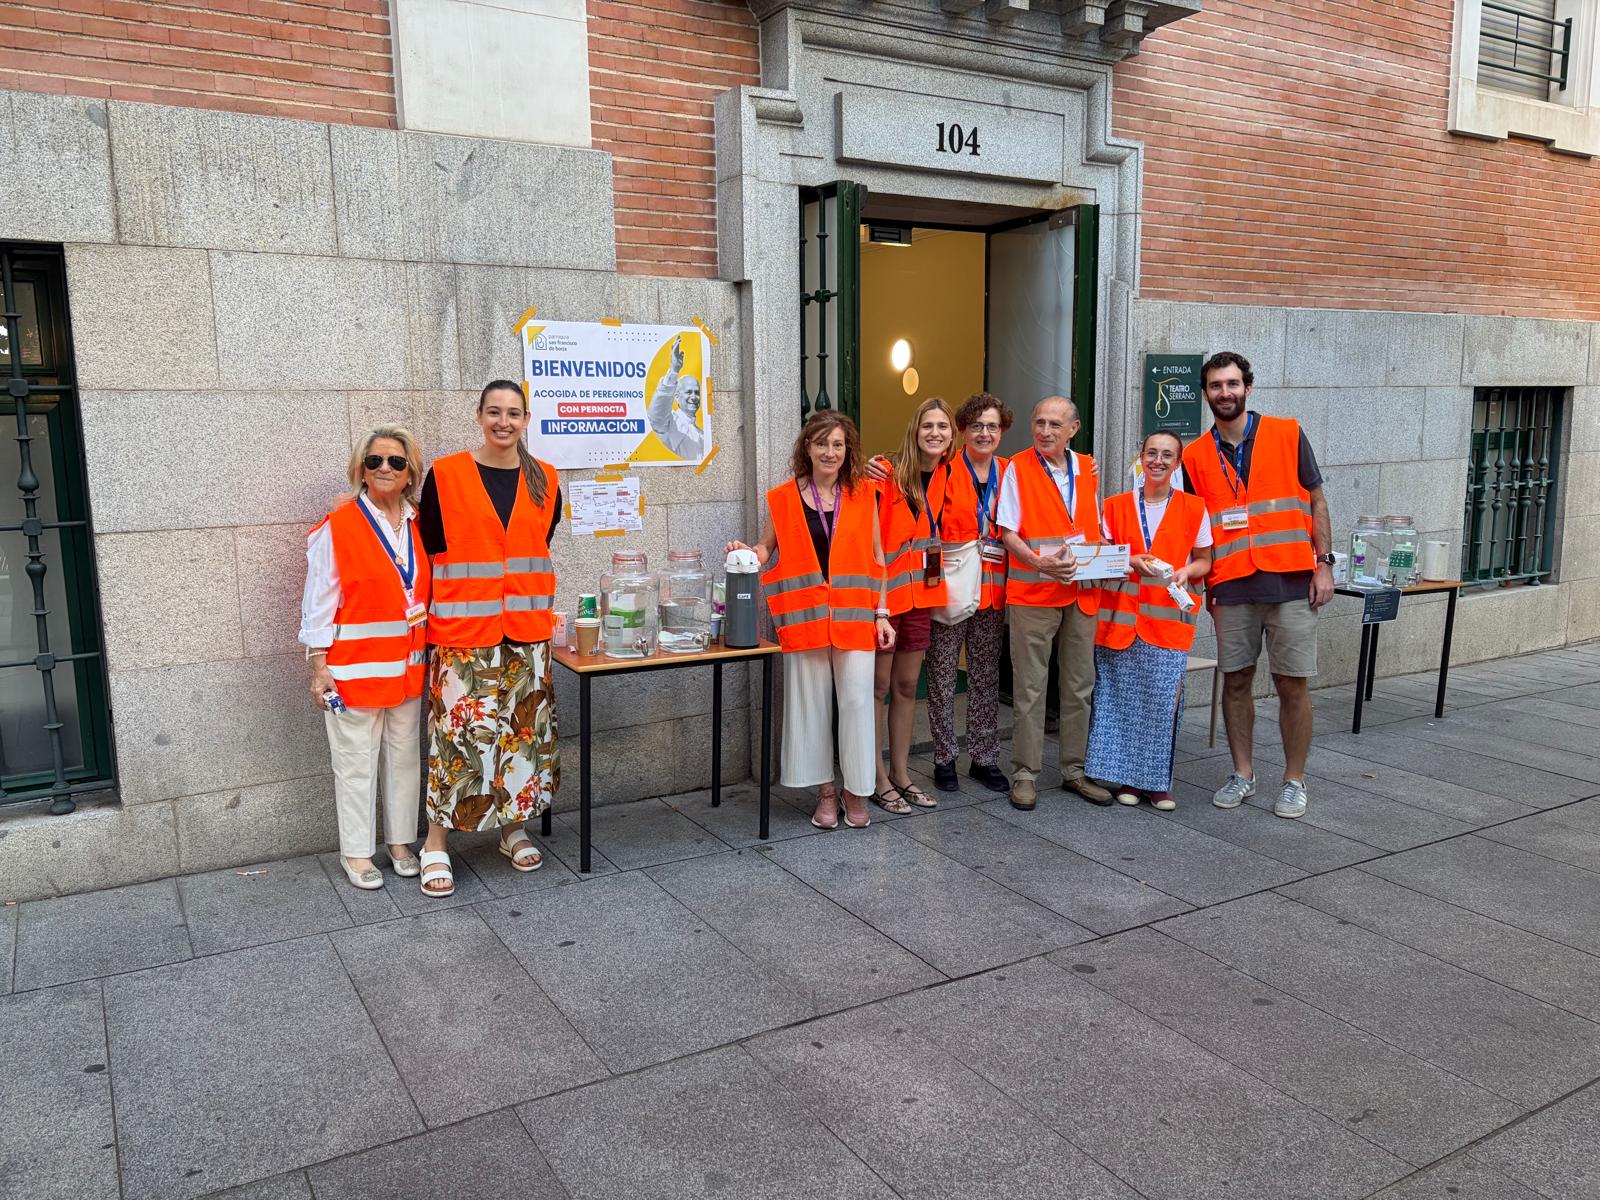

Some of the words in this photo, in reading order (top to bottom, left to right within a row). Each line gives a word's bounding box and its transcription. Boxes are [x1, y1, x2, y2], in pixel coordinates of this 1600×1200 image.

[935, 122, 980, 156] 104
[532, 359, 646, 378] BIENVENIDOS
[1163, 366, 1192, 374] ENTRADA
[534, 390, 577, 399] ACOGIDA
[579, 390, 591, 399] DE
[592, 390, 644, 399] PEREGRINOS
[1169, 392, 1196, 400] SERRANO
[580, 405, 625, 413] PERNOCTA
[548, 418, 638, 433] INFORMACIÓN
